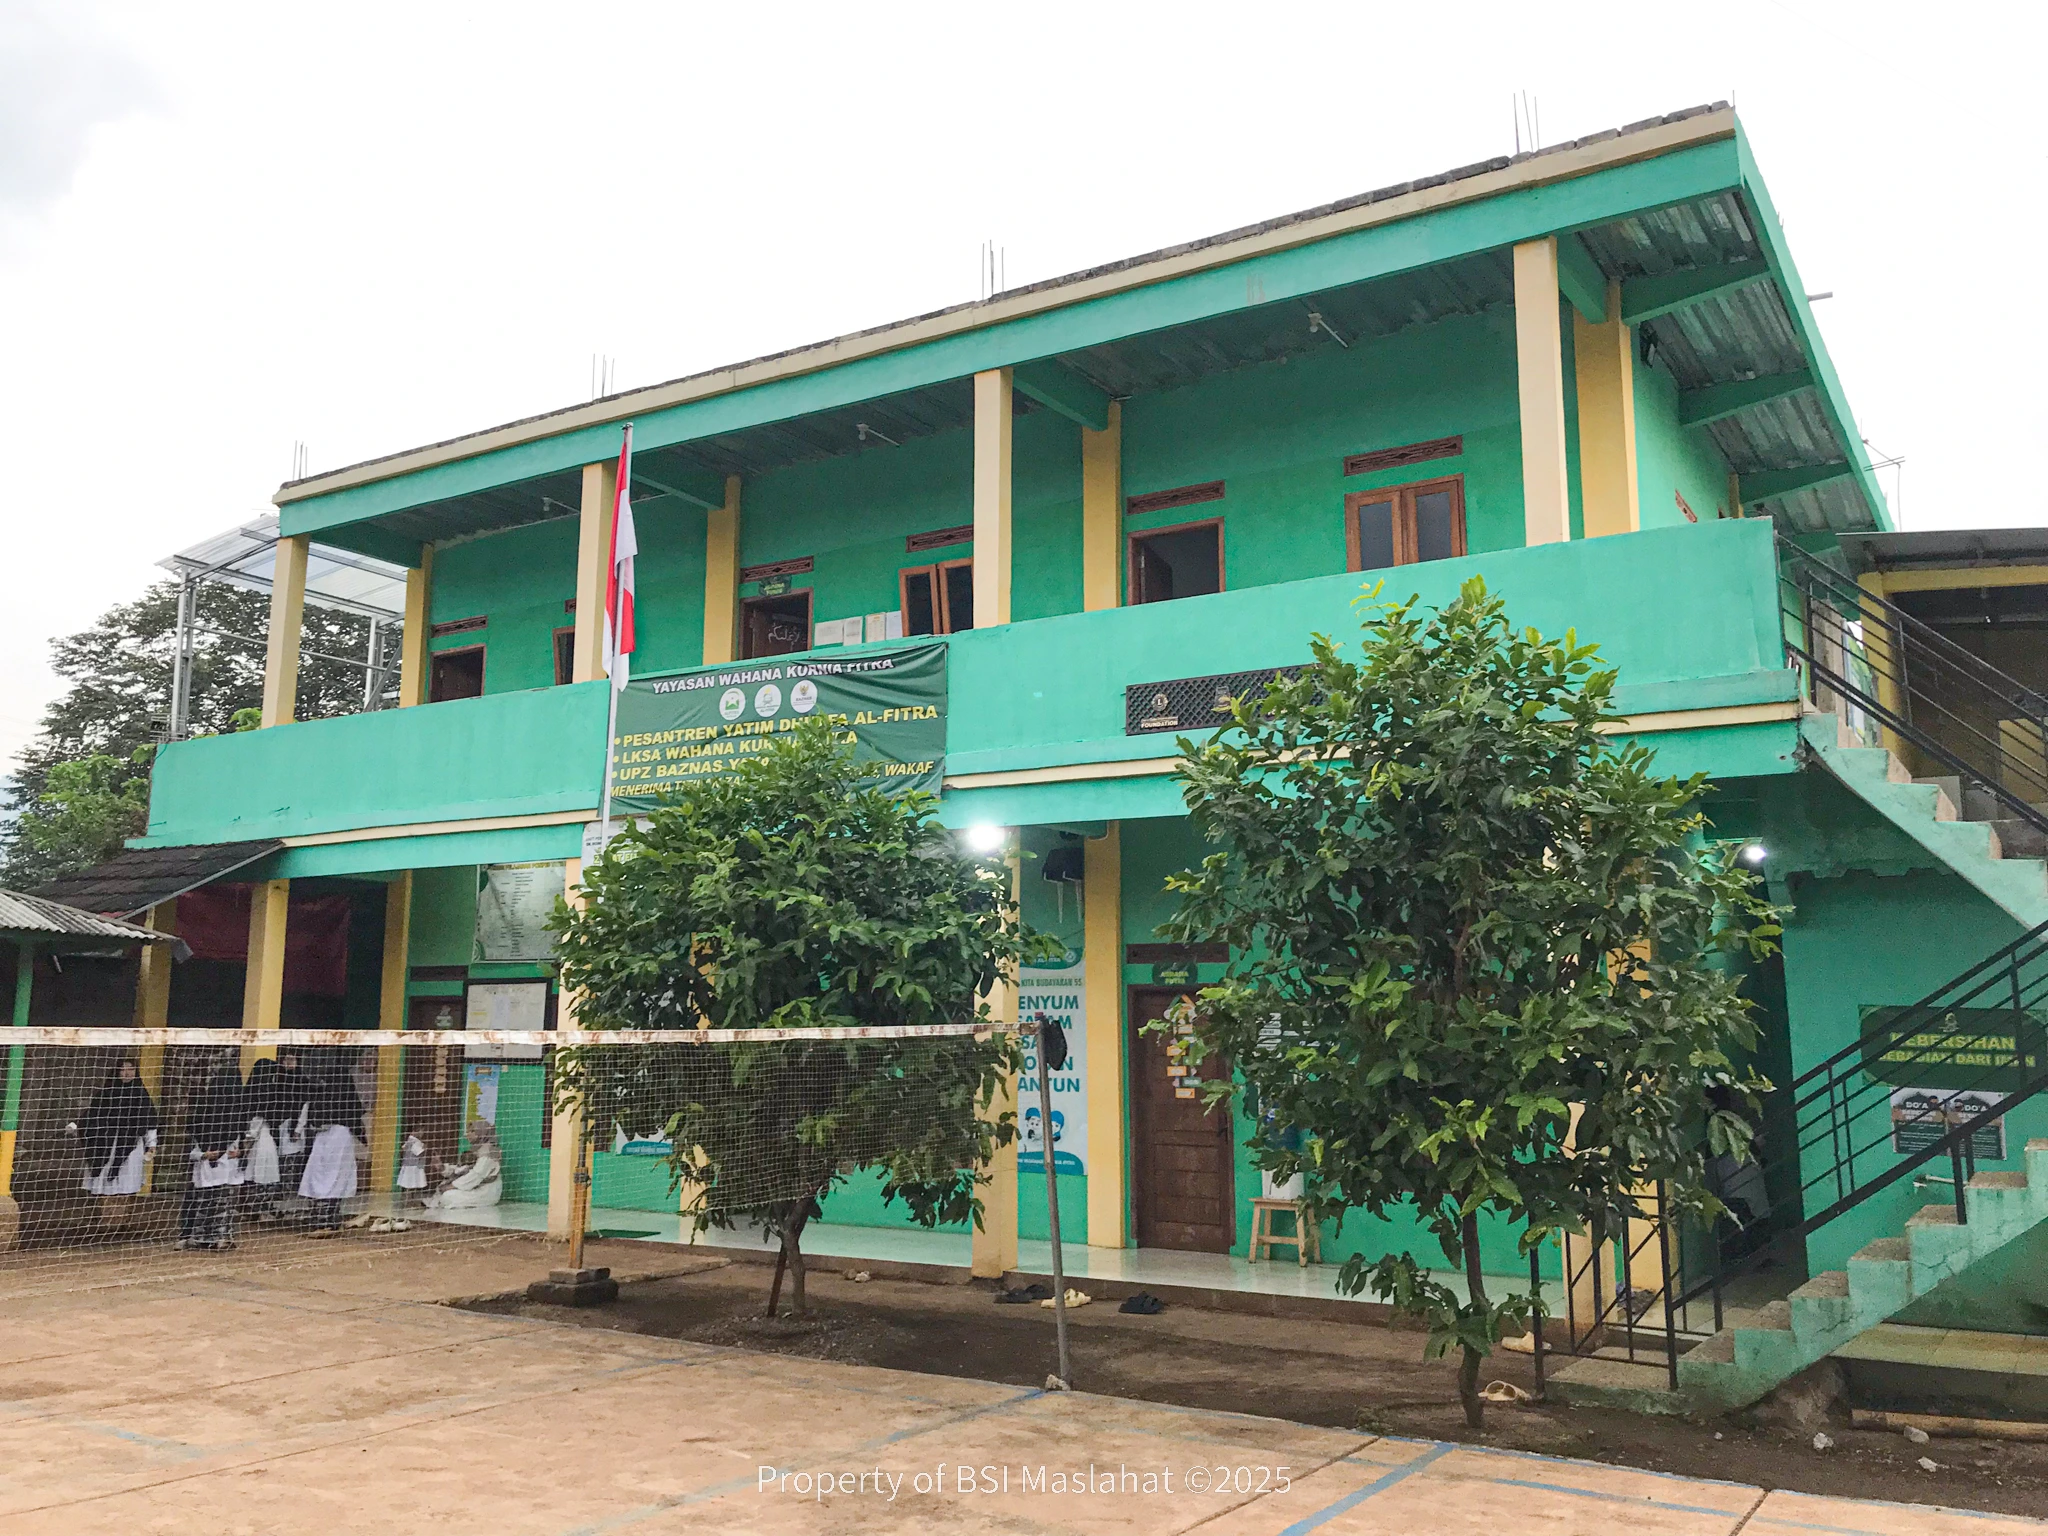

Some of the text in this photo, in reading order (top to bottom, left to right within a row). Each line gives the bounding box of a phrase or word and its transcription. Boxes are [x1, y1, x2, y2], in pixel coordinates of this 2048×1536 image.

[653, 676, 715, 694] YAYASAN
[719, 668, 782, 686] WAHANA
[786, 663, 842, 678] KURNIA
[623, 726, 717, 748] PESANTREN
[723, 720, 774, 738] YATIM
[854, 705, 938, 726] AL-FITRA
[622, 749, 661, 764] LKSA
[666, 742, 734, 760] WAHANA
[611, 781, 671, 797] MENERIMA
[885, 761, 934, 777] WAKAF
[620, 767, 651, 781] UPZ
[656, 760, 722, 778] BAZNAS
[1018, 995, 1079, 1010] ENYUM
[1956, 1053, 1991, 1066] DARI
[1018, 1077, 1080, 1092] ANUN
